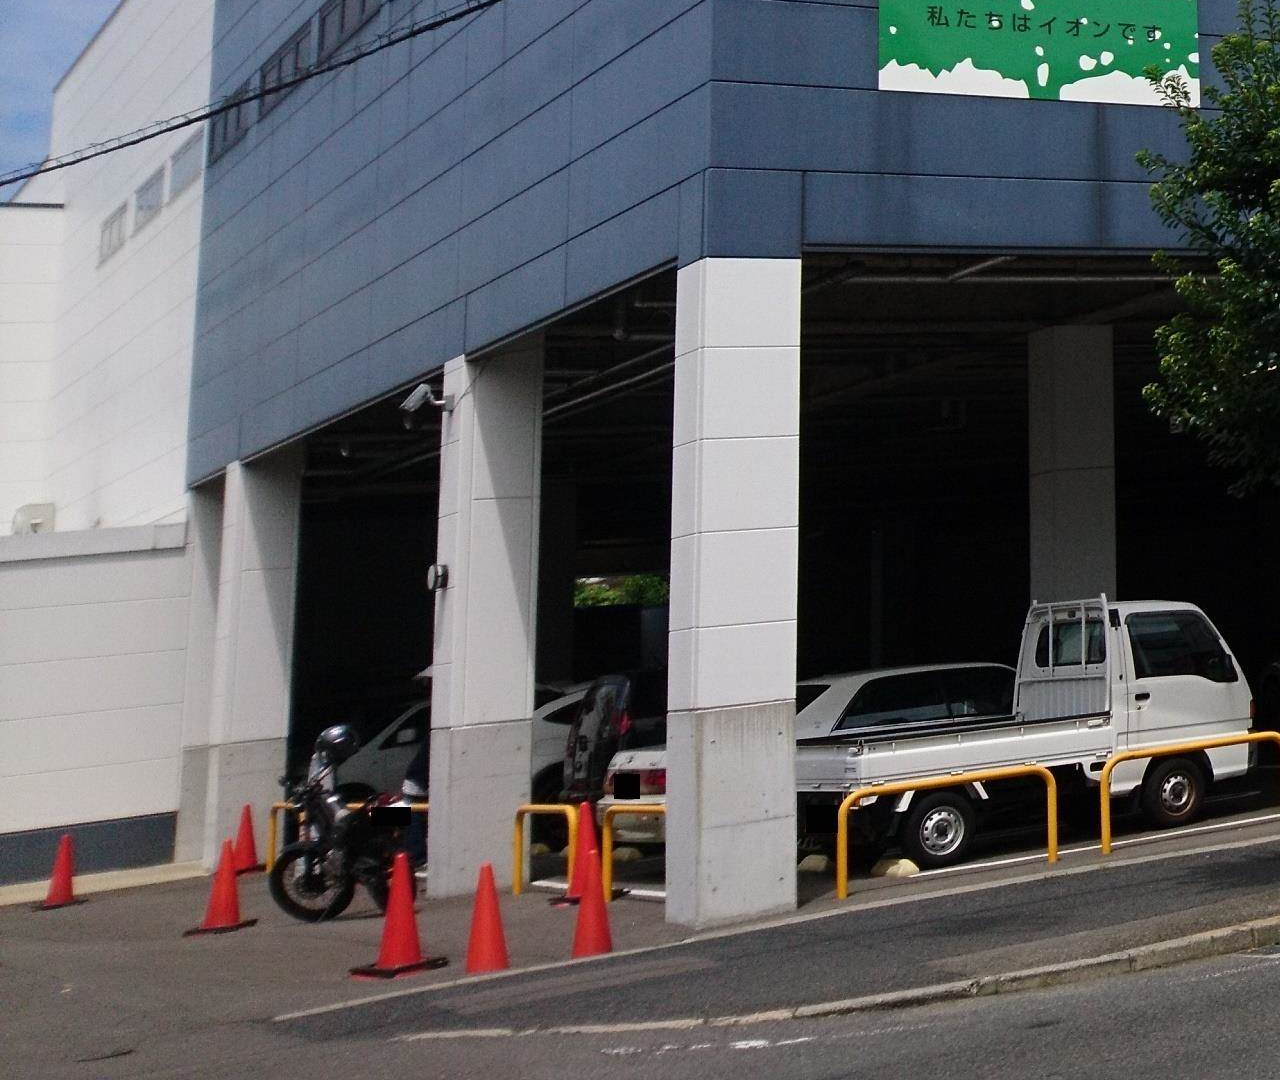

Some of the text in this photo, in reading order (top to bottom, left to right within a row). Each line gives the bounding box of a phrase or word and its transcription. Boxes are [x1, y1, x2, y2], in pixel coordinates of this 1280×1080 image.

[927, 5, 1162, 43] 私たちはイオンです
